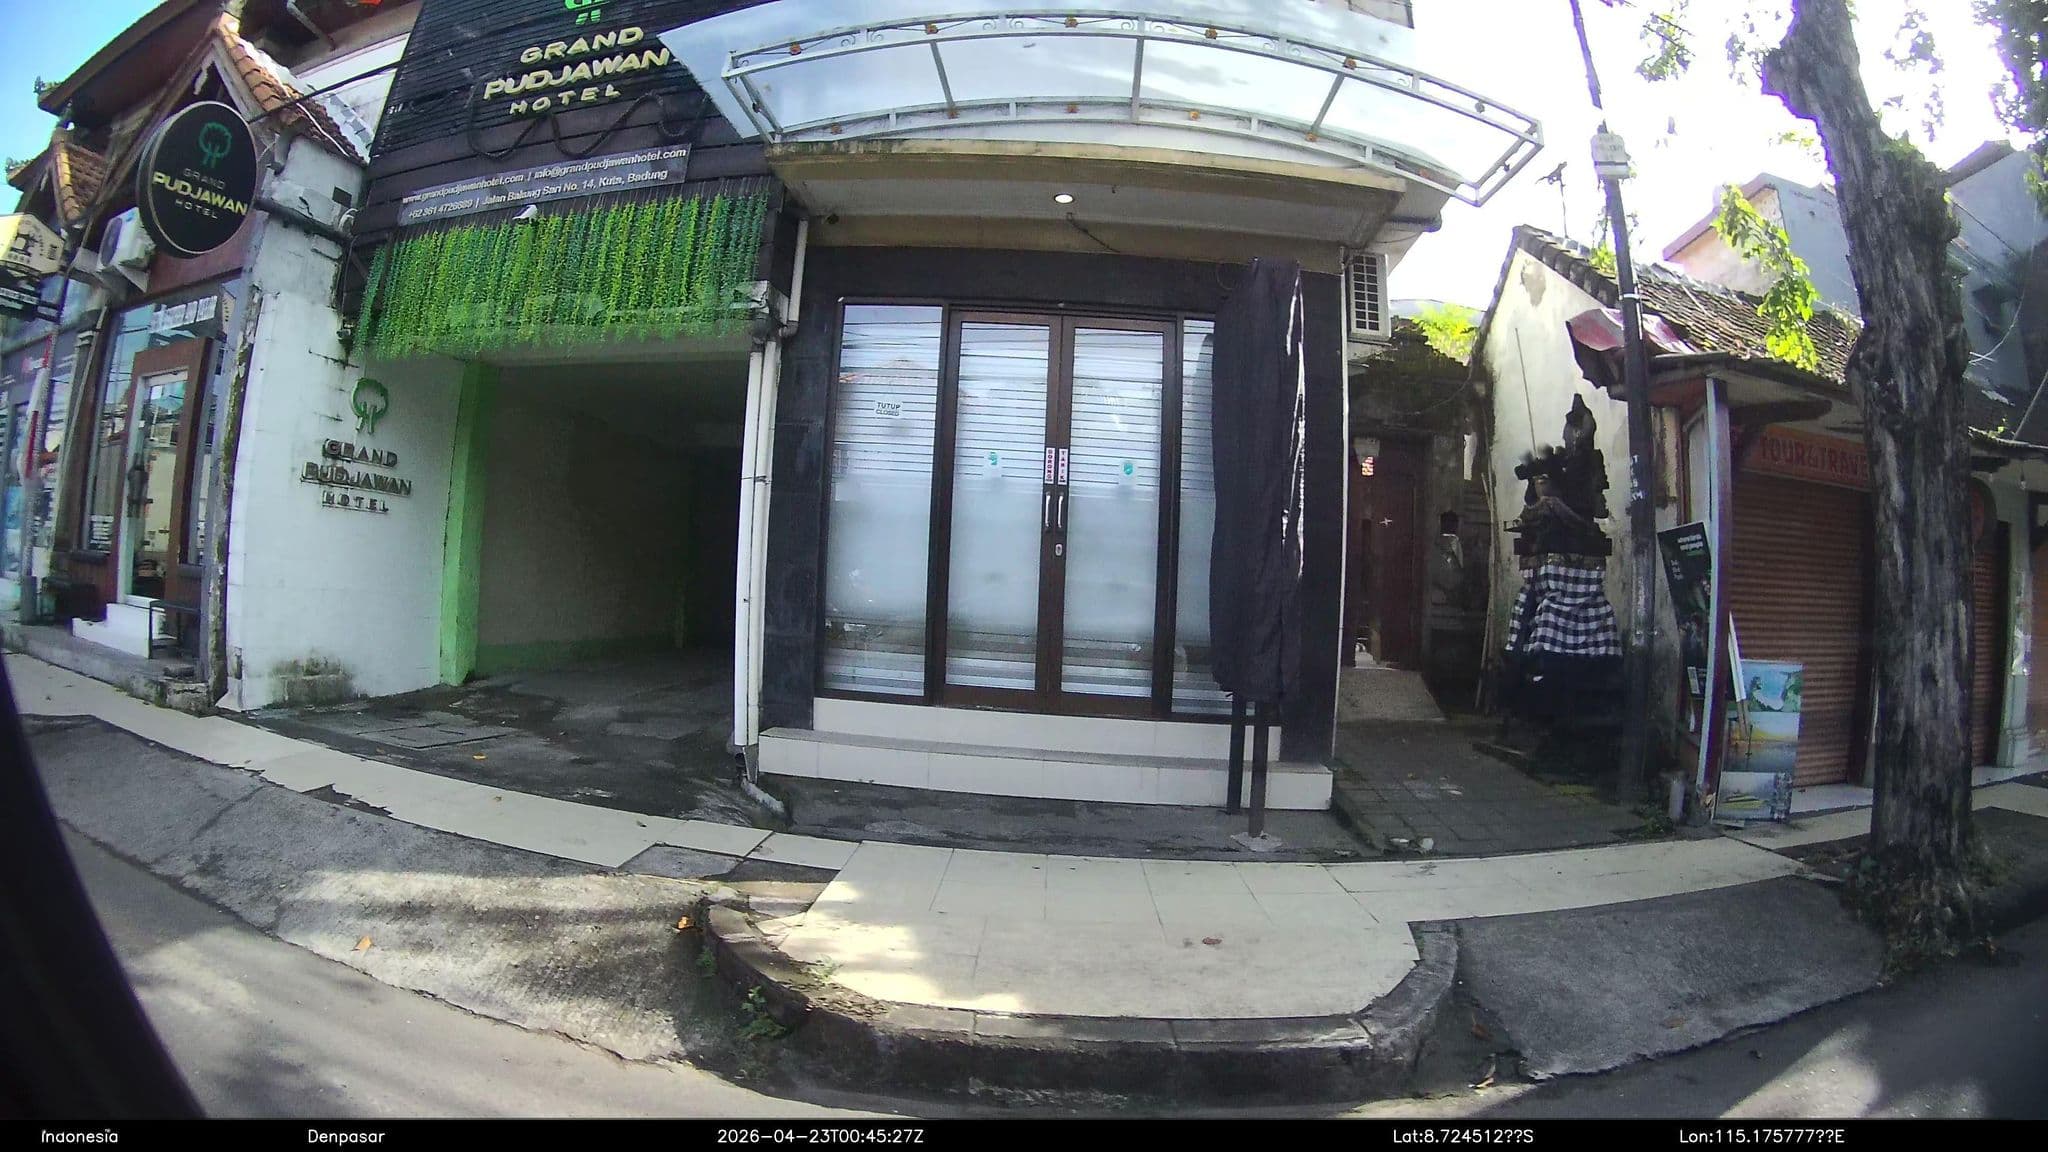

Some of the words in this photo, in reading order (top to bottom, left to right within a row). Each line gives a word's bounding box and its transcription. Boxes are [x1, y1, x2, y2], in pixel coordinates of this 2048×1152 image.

[520, 26, 644, 64] GRAND
[484, 48, 670, 100] PUDJAWAN
[510, 84, 622, 115] HOTEL
[183, 167, 226, 190] GRAND
[534, 149, 686, 180] info@grandpudjawanhotel.com
[152, 171, 248, 216] PUDJAWAN
[482, 193, 507, 206] Jalan
[543, 184, 562, 196] Sari
[599, 174, 625, 188] Kuta,
[627, 168, 669, 183] Badung
[174, 199, 218, 220] HOTEL
[877, 401, 901, 410] TUTUP
[322, 439, 398, 468] GRAND
[1820, 447, 1869, 481] TRAVE
[301, 461, 412, 497] PUDJAWAN
[321, 490, 389, 513] HOTEL
